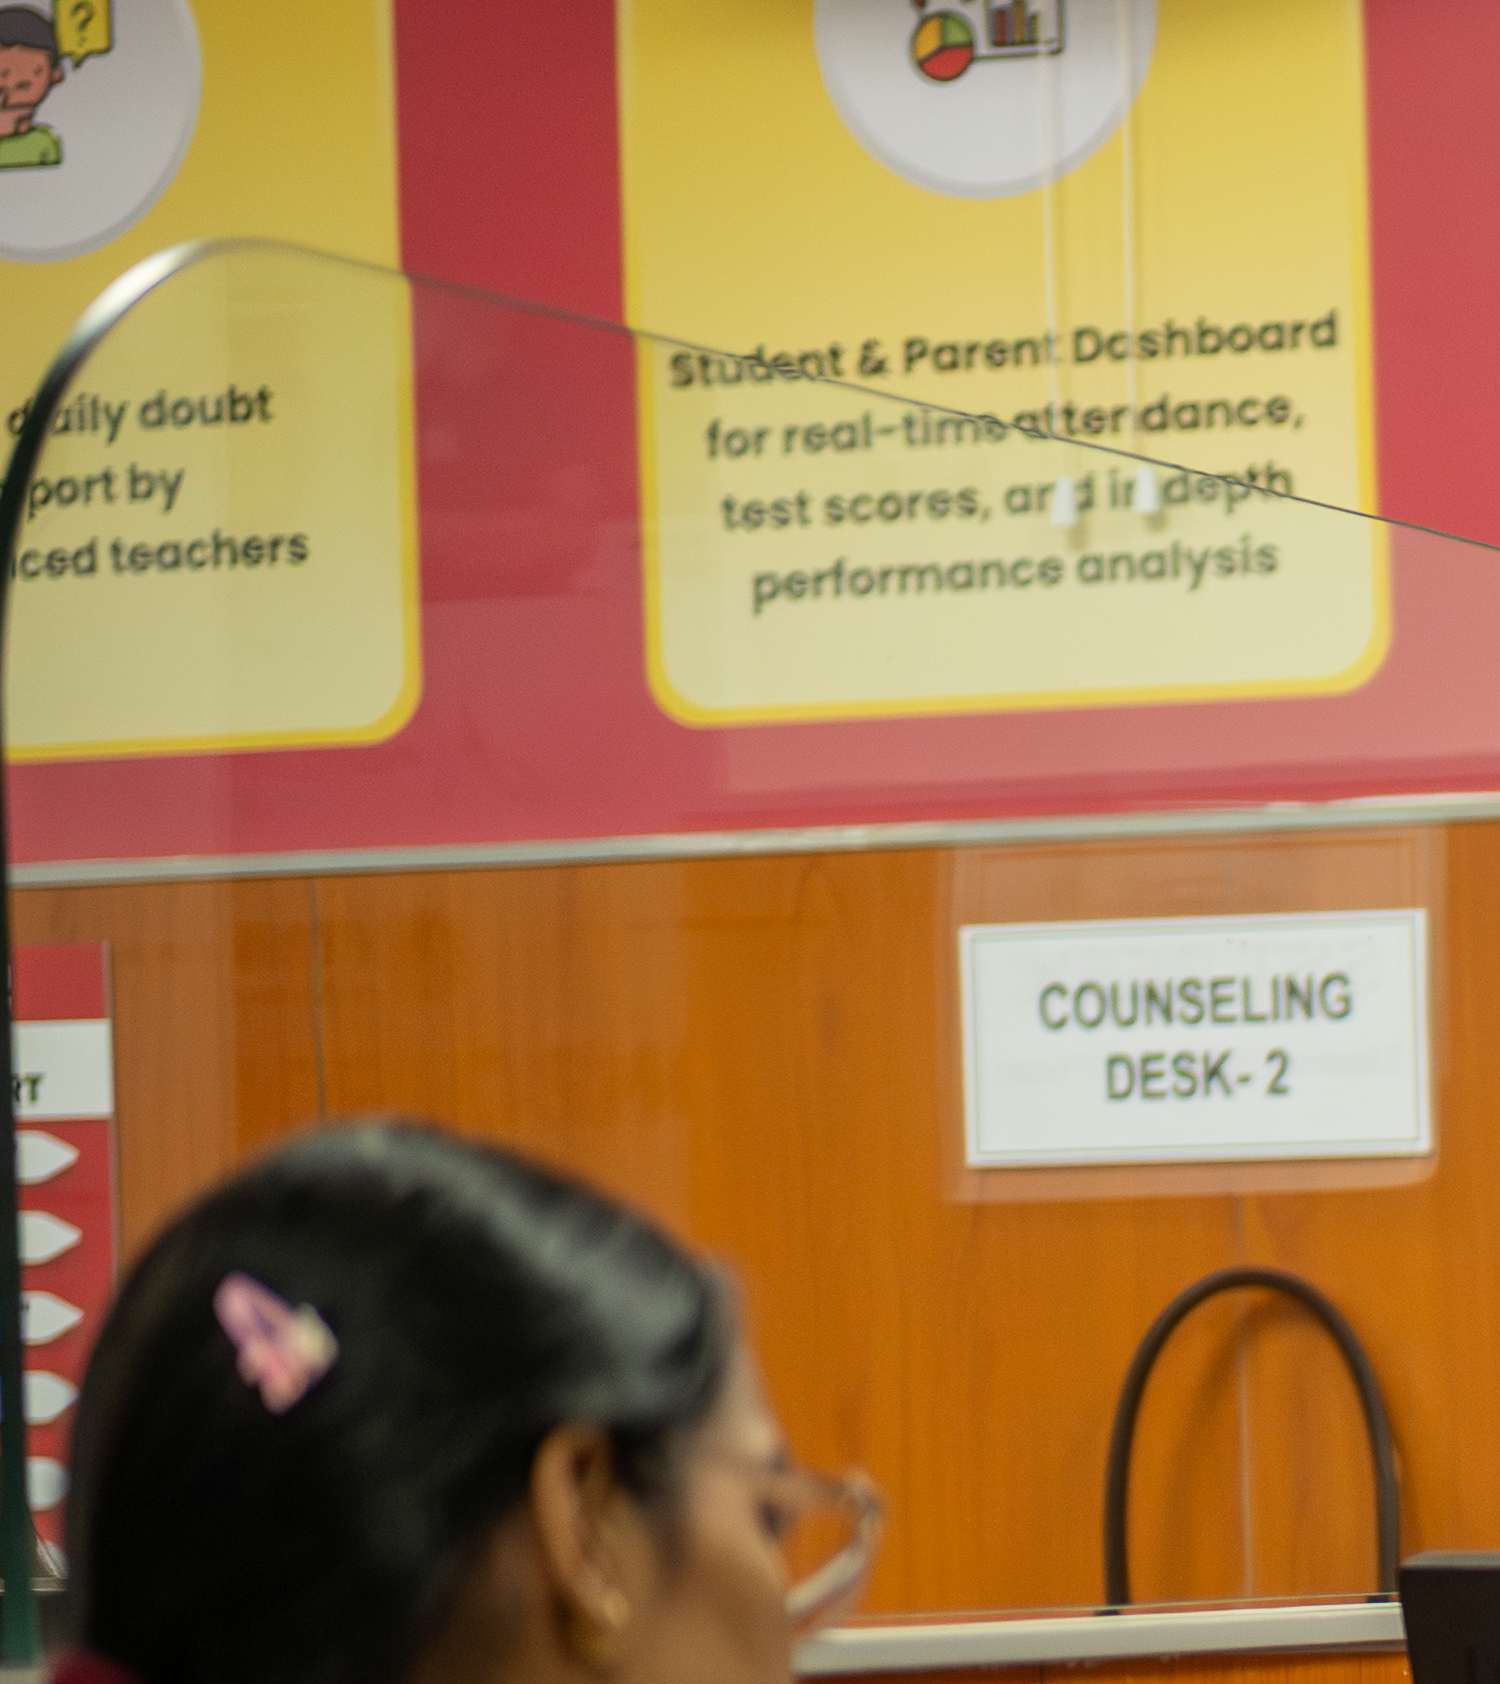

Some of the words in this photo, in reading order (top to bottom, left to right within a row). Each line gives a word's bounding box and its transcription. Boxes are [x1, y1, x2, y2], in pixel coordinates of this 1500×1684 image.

[669, 343, 845, 389] Student
[858, 338, 888, 377] &
[903, 330, 1056, 375] Parent
[1072, 308, 1339, 364] Dashboard
[138, 384, 275, 430] doubt
[706, 418, 768, 461] for
[783, 402, 1011, 456] real-time
[27, 464, 117, 522] port
[128, 461, 185, 513] by
[721, 490, 812, 532] test
[824, 482, 992, 528] scores,
[1162, 464, 1294, 515] depth
[110, 527, 310, 577] teachers
[752, 549, 1063, 615] performance
[1076, 533, 1279, 591] analysis
[1038, 971, 1353, 1031] COUNSELING
